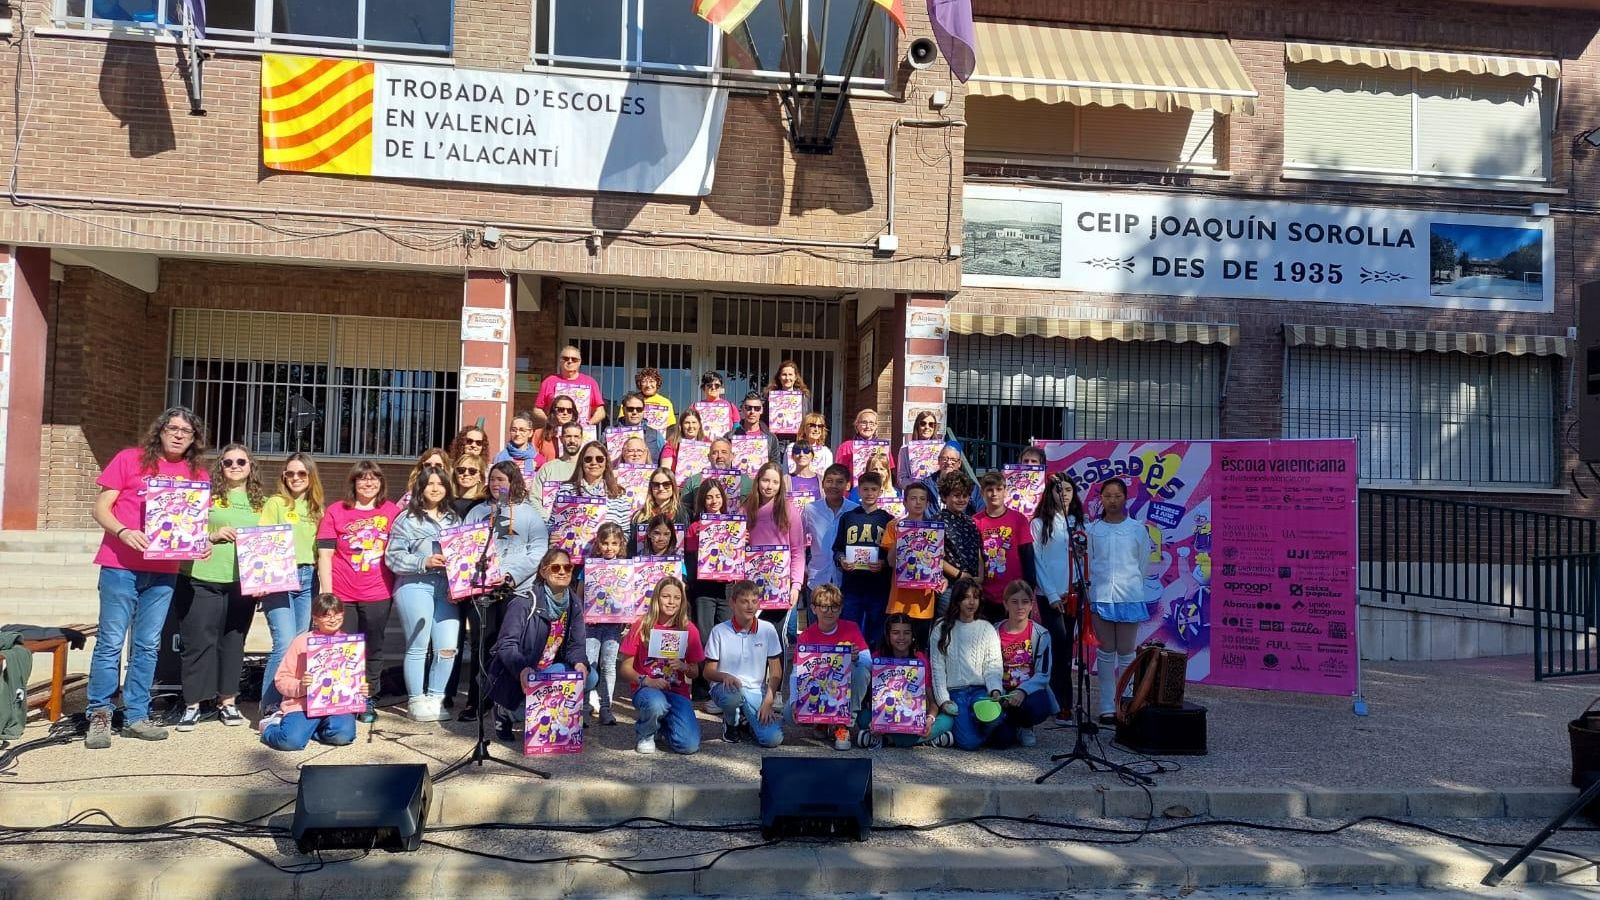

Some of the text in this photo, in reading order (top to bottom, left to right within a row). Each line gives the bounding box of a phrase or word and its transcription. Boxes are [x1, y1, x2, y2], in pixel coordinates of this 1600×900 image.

[386, 78, 504, 105] TROBADA
[386, 108, 538, 136] EN VALENCIÀ
[386, 139, 414, 159] DE
[1076, 211, 1415, 249] CEIP JOAQUÍN SOROLLA
[1152, 256, 1344, 285] DES DE 1935
[1269, 458, 1346, 473] valenciana
